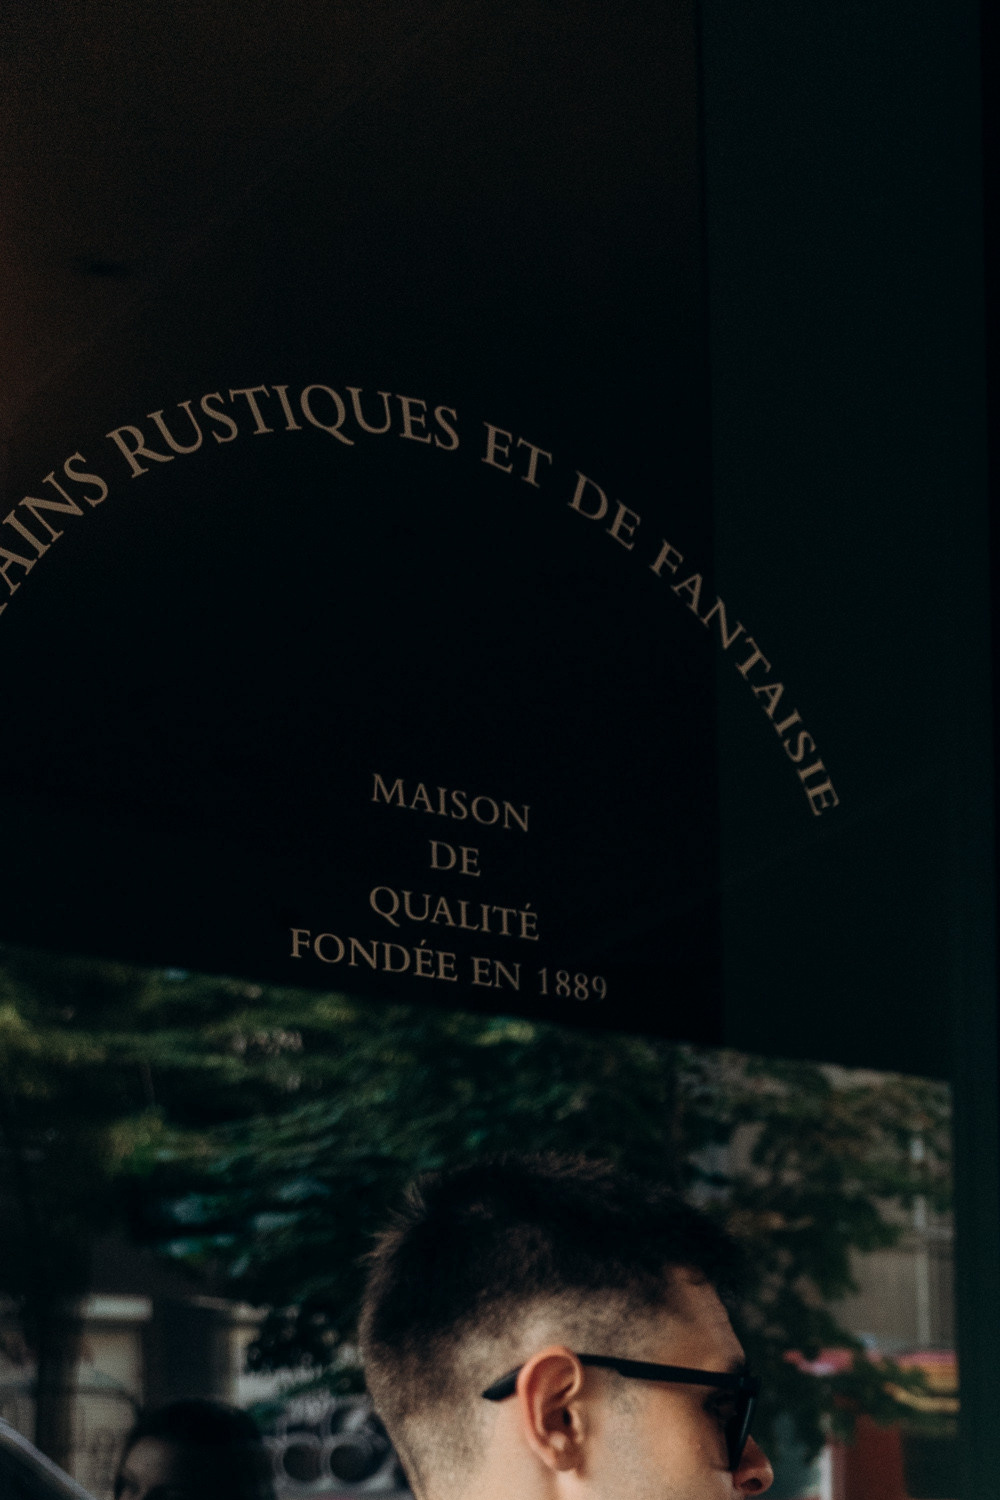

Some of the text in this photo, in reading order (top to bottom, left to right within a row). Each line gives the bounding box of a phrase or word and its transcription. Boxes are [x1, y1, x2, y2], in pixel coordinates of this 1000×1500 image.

[0, 384, 840, 816] AINS RUSTIQUES ET DE FANTAISIE
[371, 773, 531, 832] MAISON
[429, 840, 482, 877] DE
[369, 886, 540, 941] QUALITÉ
[290, 928, 608, 1001] FONDÉE EN 1889
